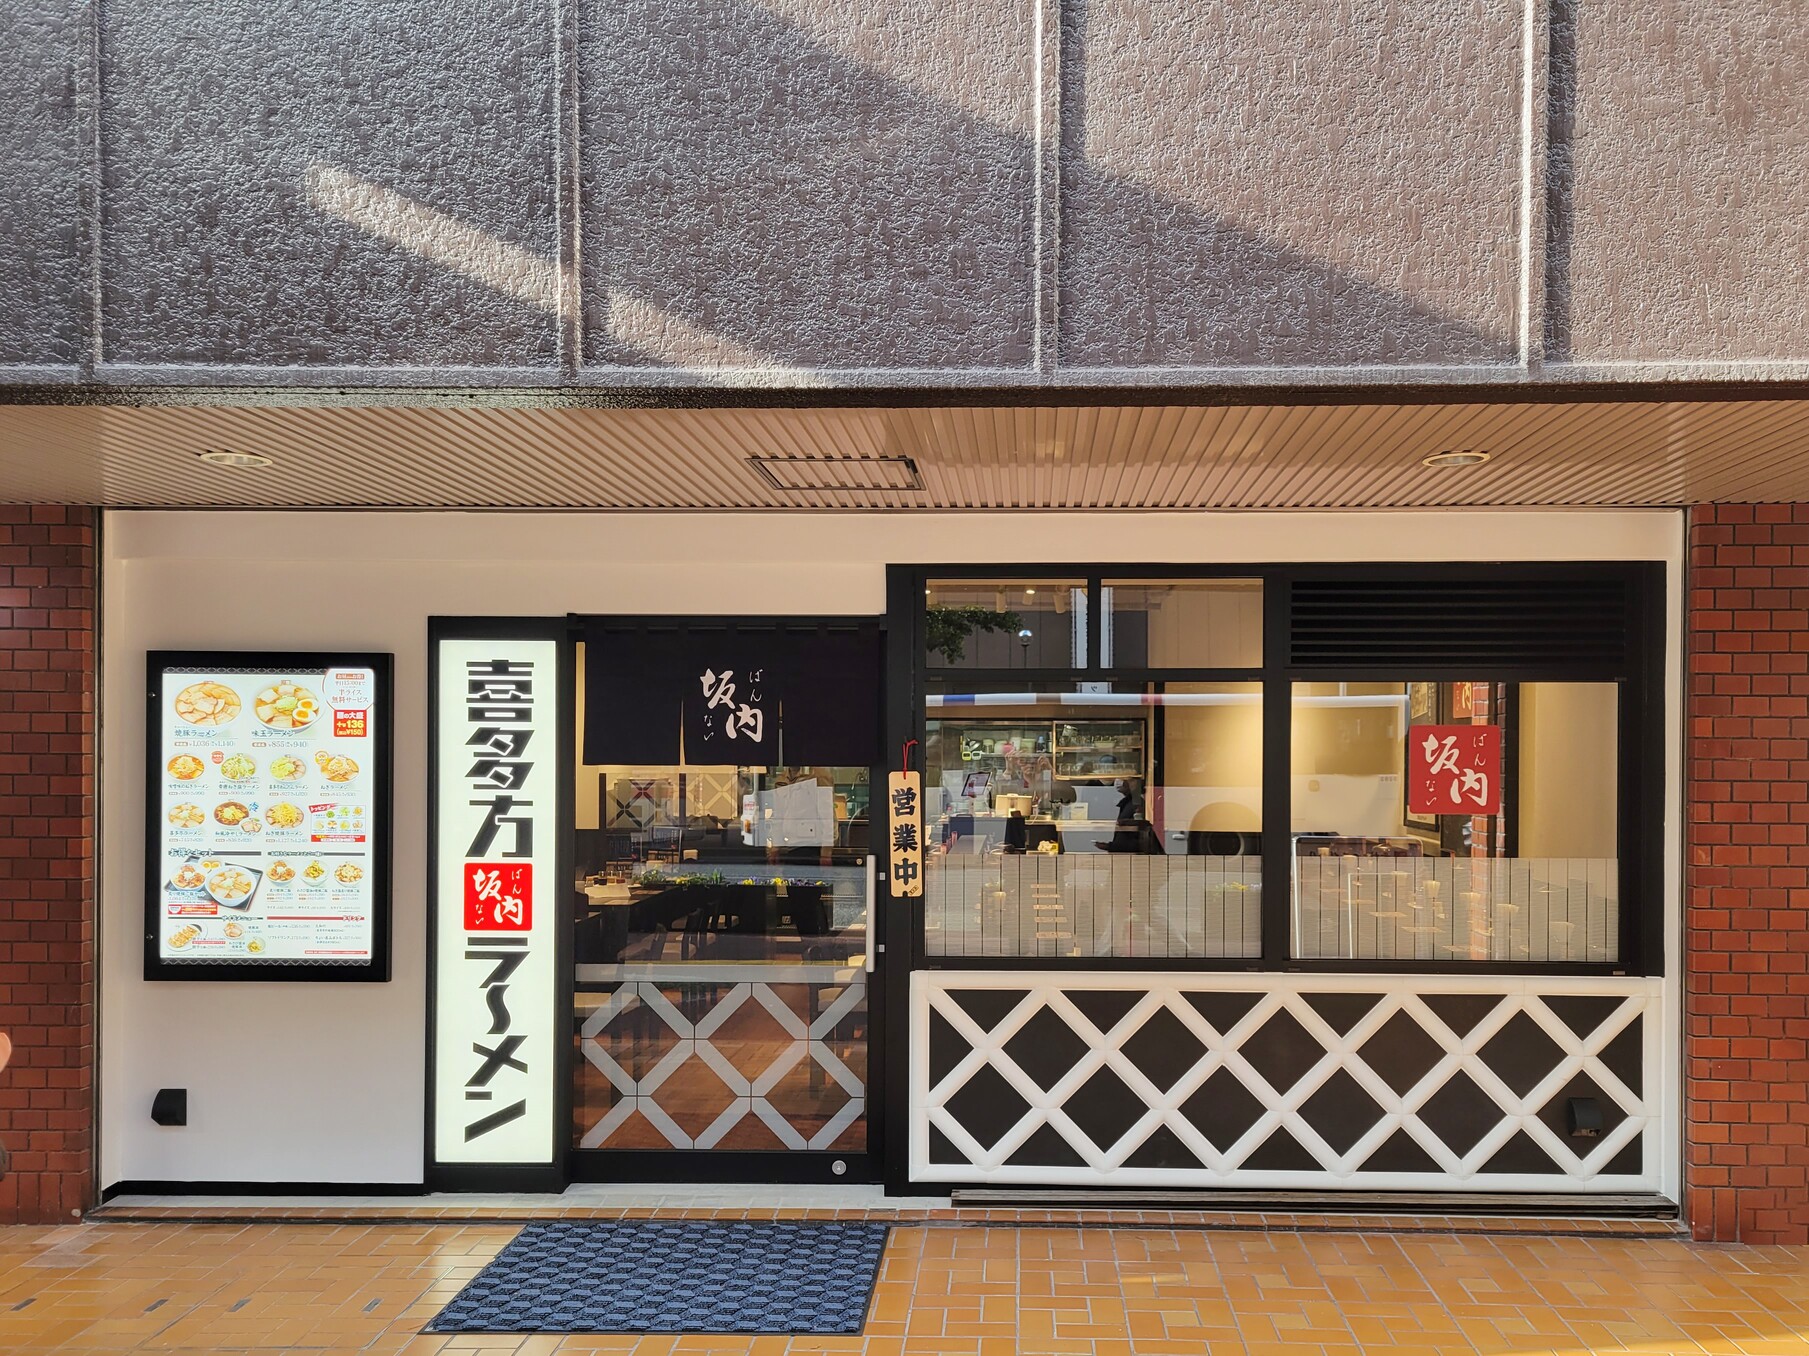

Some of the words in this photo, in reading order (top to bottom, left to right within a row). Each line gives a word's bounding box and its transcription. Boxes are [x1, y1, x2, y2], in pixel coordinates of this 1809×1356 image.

[749, 668, 763, 702] ばん
[699, 668, 764, 743] 坂内
[174, 729, 217, 738] 焼豚ラーメン
[251, 730, 295, 738] 味玉ラーメン
[703, 714, 714, 741] ない
[464, 659, 536, 859] 喜多方
[1473, 733, 1488, 766] ばん
[1421, 733, 1489, 807] 坂内
[1425, 780, 1437, 806] ない
[891, 786, 918, 886] 営業中
[472, 868, 523, 926] 坂内
[511, 868, 523, 894] ばん
[475, 904, 484, 925] ない
